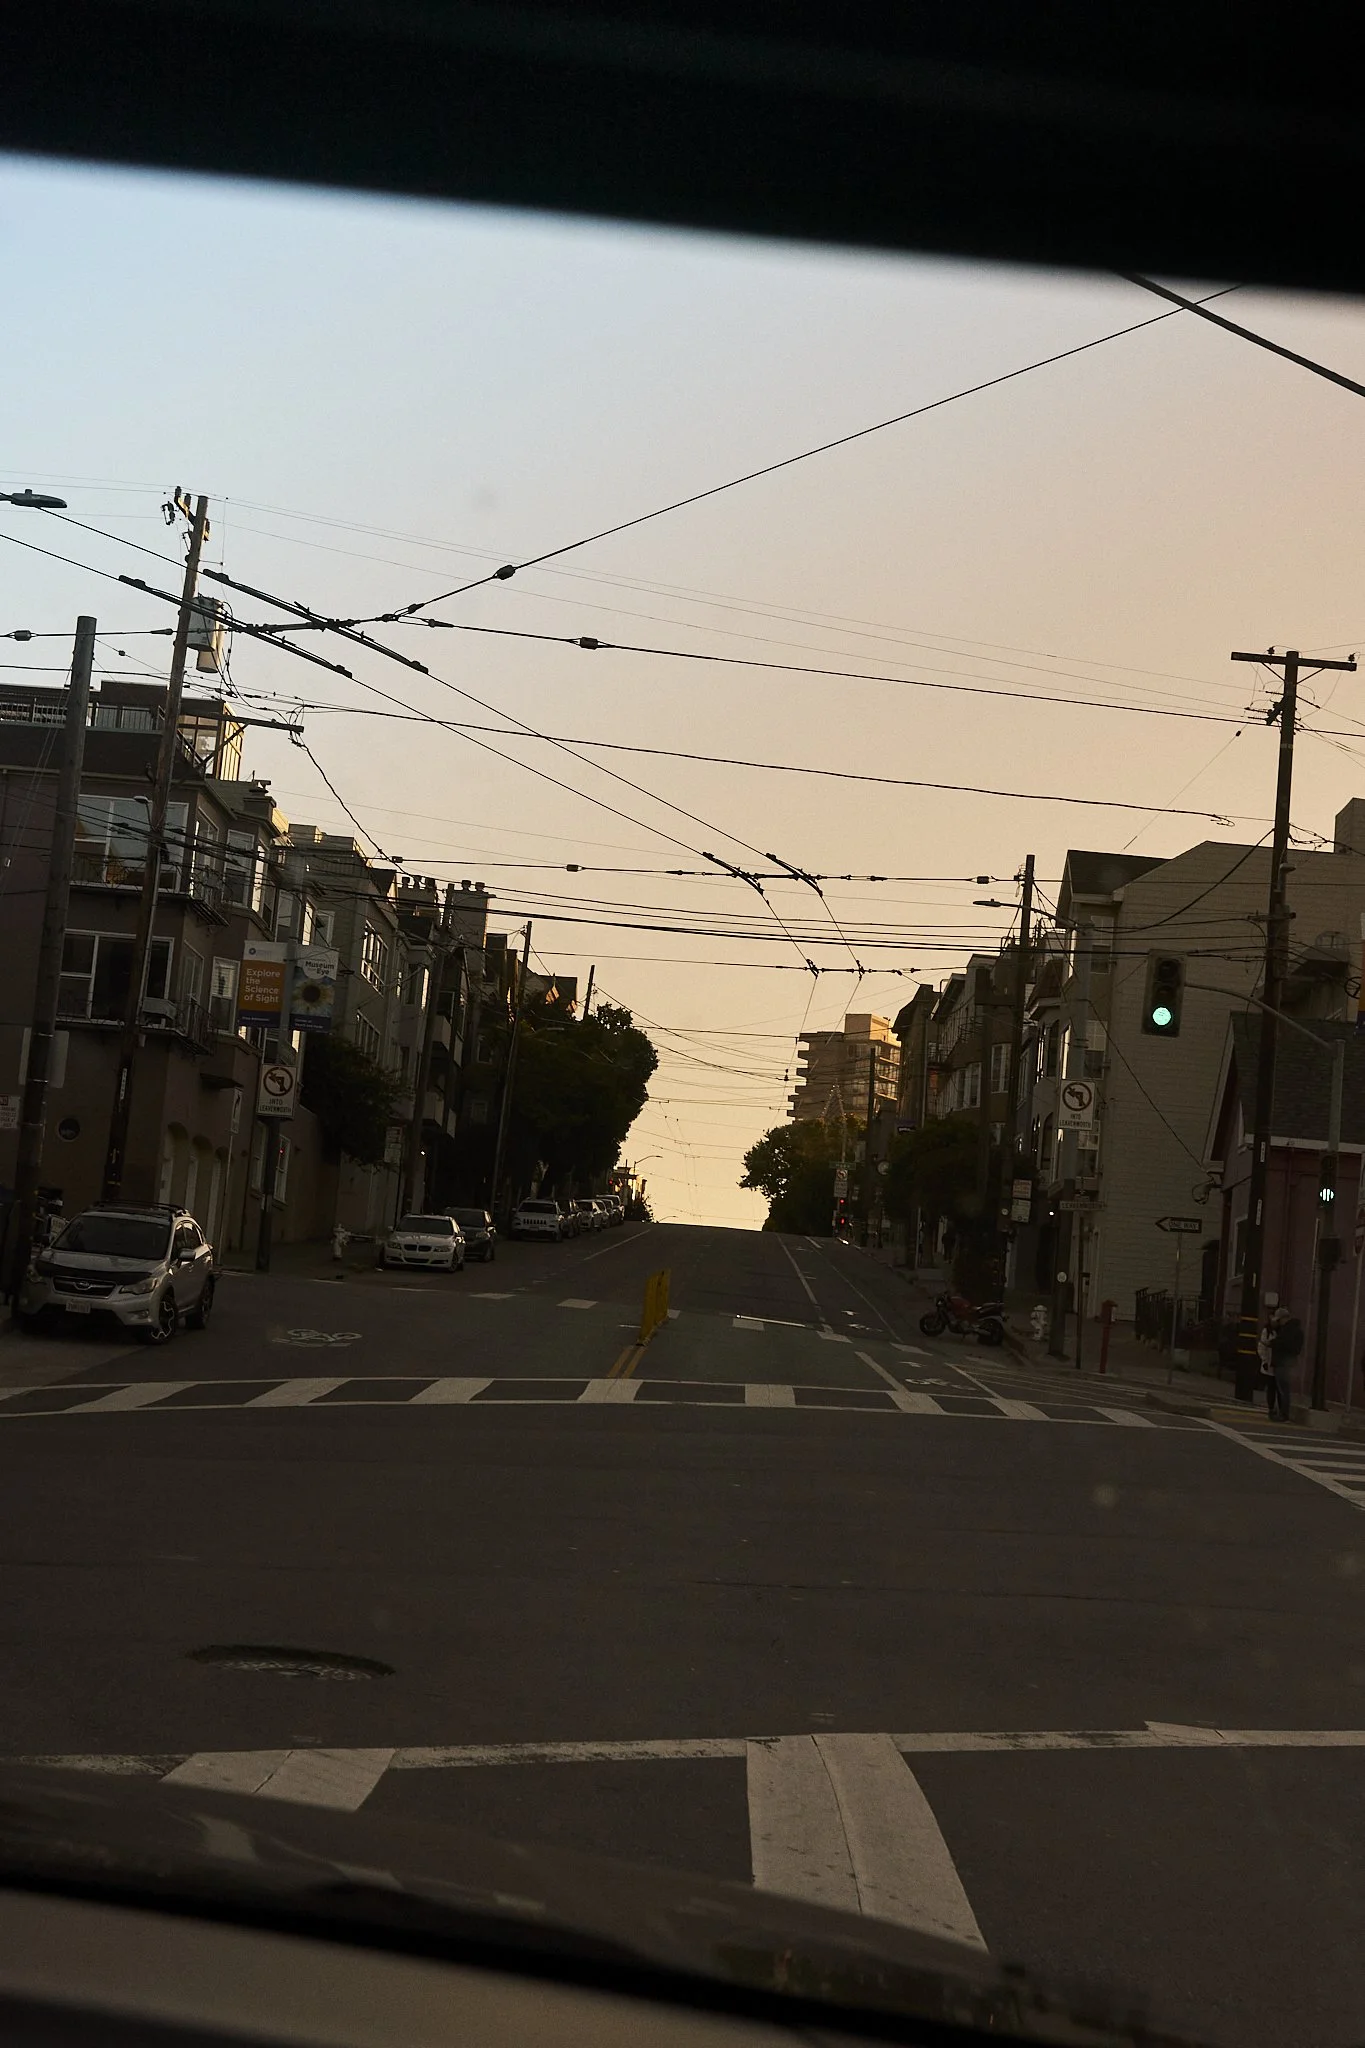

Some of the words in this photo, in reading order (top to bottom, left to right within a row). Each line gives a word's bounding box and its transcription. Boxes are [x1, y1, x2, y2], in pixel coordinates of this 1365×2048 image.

[305, 961, 334, 970] Museum
[246, 968, 281, 978] Explore
[316, 968, 330, 976] Eye
[246, 977, 261, 985] the
[245, 986, 280, 995] Science
[255, 994, 280, 1004] Sight
[1183, 1222, 1198, 1230] WAY
